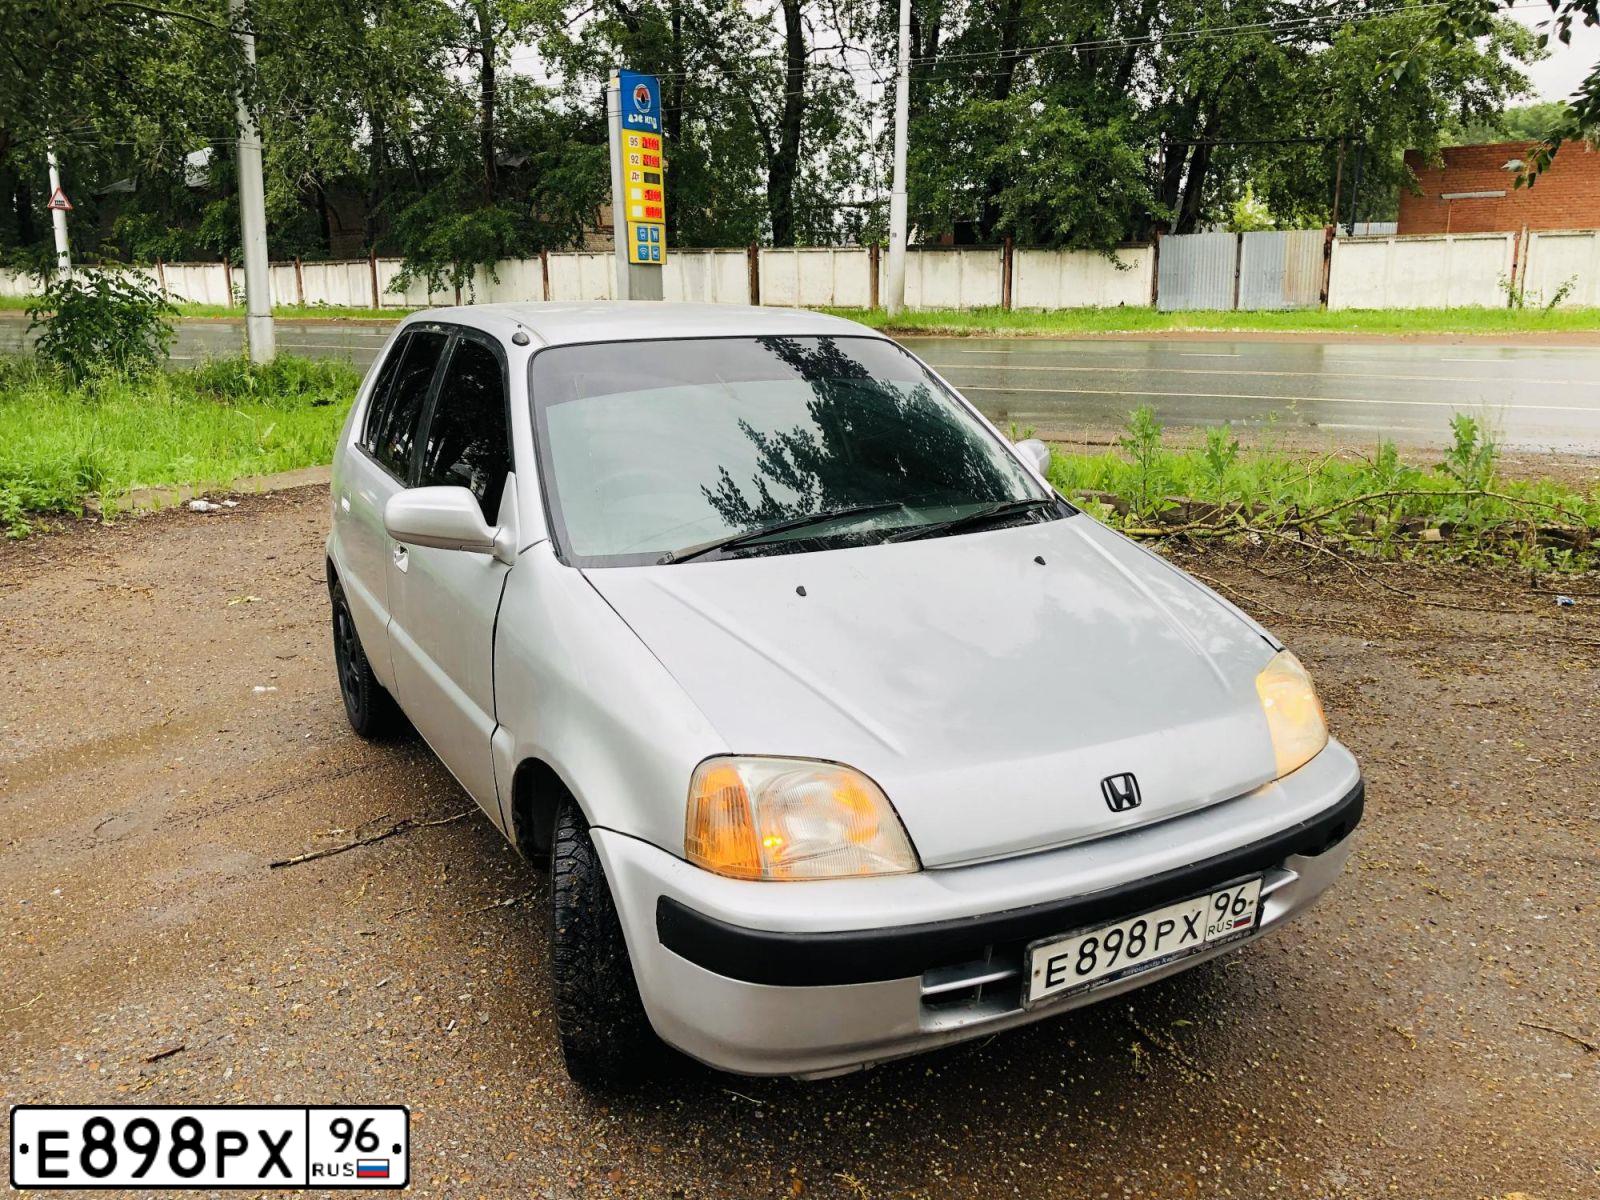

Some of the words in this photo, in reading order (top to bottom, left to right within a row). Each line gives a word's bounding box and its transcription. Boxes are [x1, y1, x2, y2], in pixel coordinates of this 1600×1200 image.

[630, 137, 639, 147] 95
[630, 155, 639, 165] 92
[1214, 887, 1247, 922] 96
[1207, 919, 1233, 936] RUS
